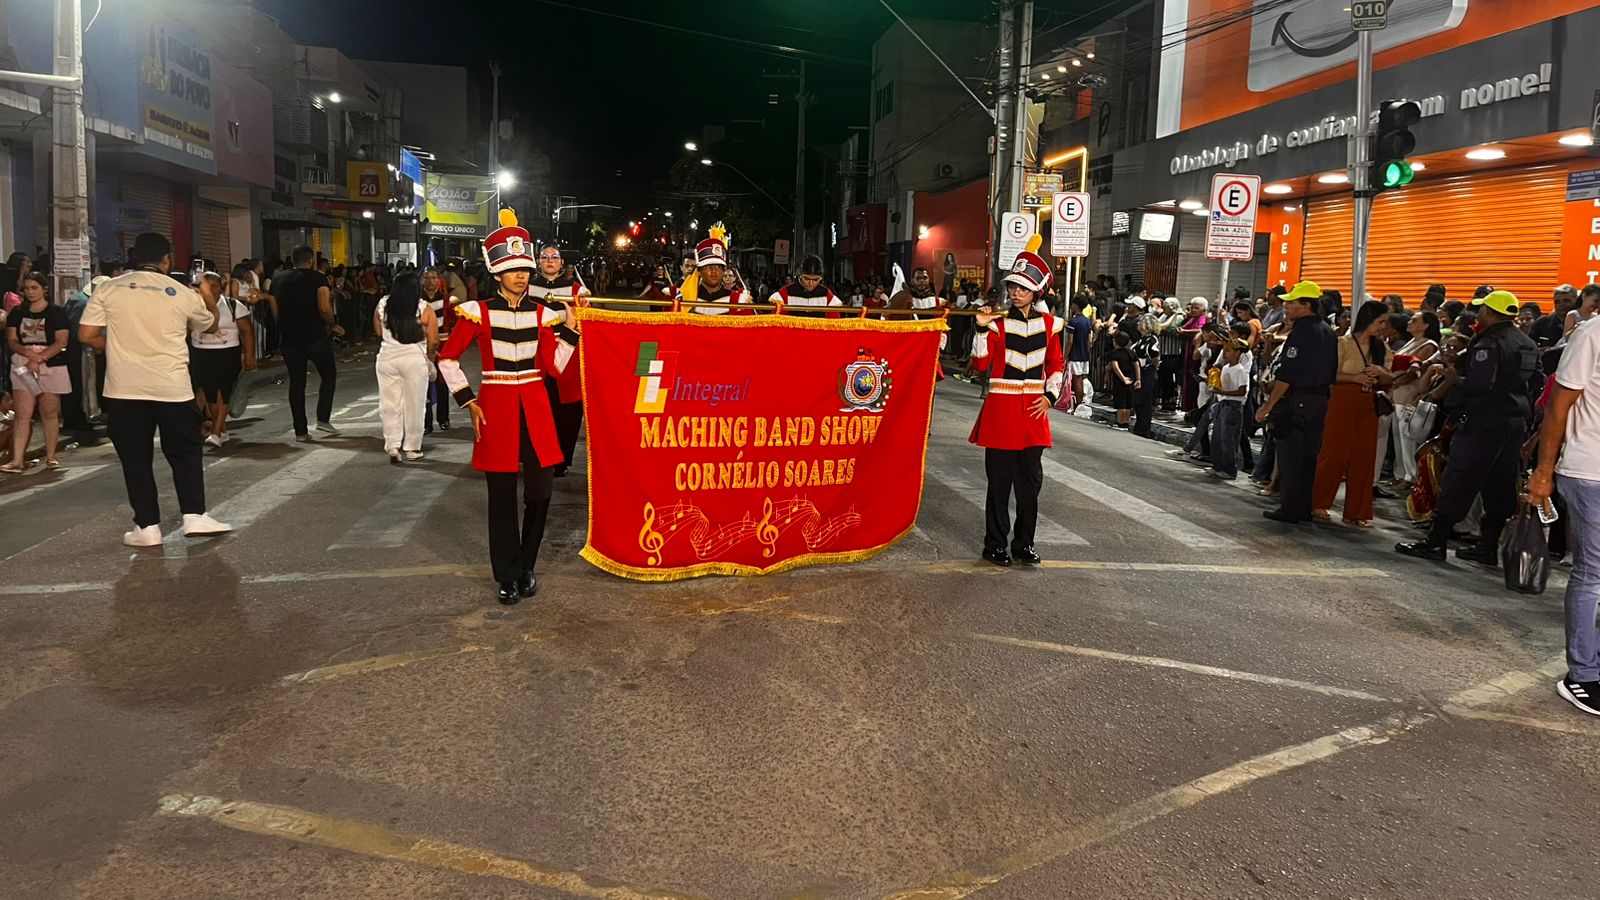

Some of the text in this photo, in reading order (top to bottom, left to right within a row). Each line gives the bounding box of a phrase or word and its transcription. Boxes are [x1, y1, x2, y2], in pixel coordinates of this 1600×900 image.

[1354, 3, 1385, 17] 010
[1256, 132, 1279, 156] de
[1286, 110, 1381, 149] confiana
[1460, 63, 1552, 110] nome!
[361, 183, 377, 195] 20
[1228, 189, 1241, 208] E
[1066, 202, 1075, 216] E
[431, 224, 476, 234] PREÇO ÚNICO
[1014, 221, 1022, 234] E
[671, 376, 751, 407] Integral
[639, 415, 884, 449] MACHING BAND SHOW
[675, 450, 857, 491] CORNÉLIO SOARES
